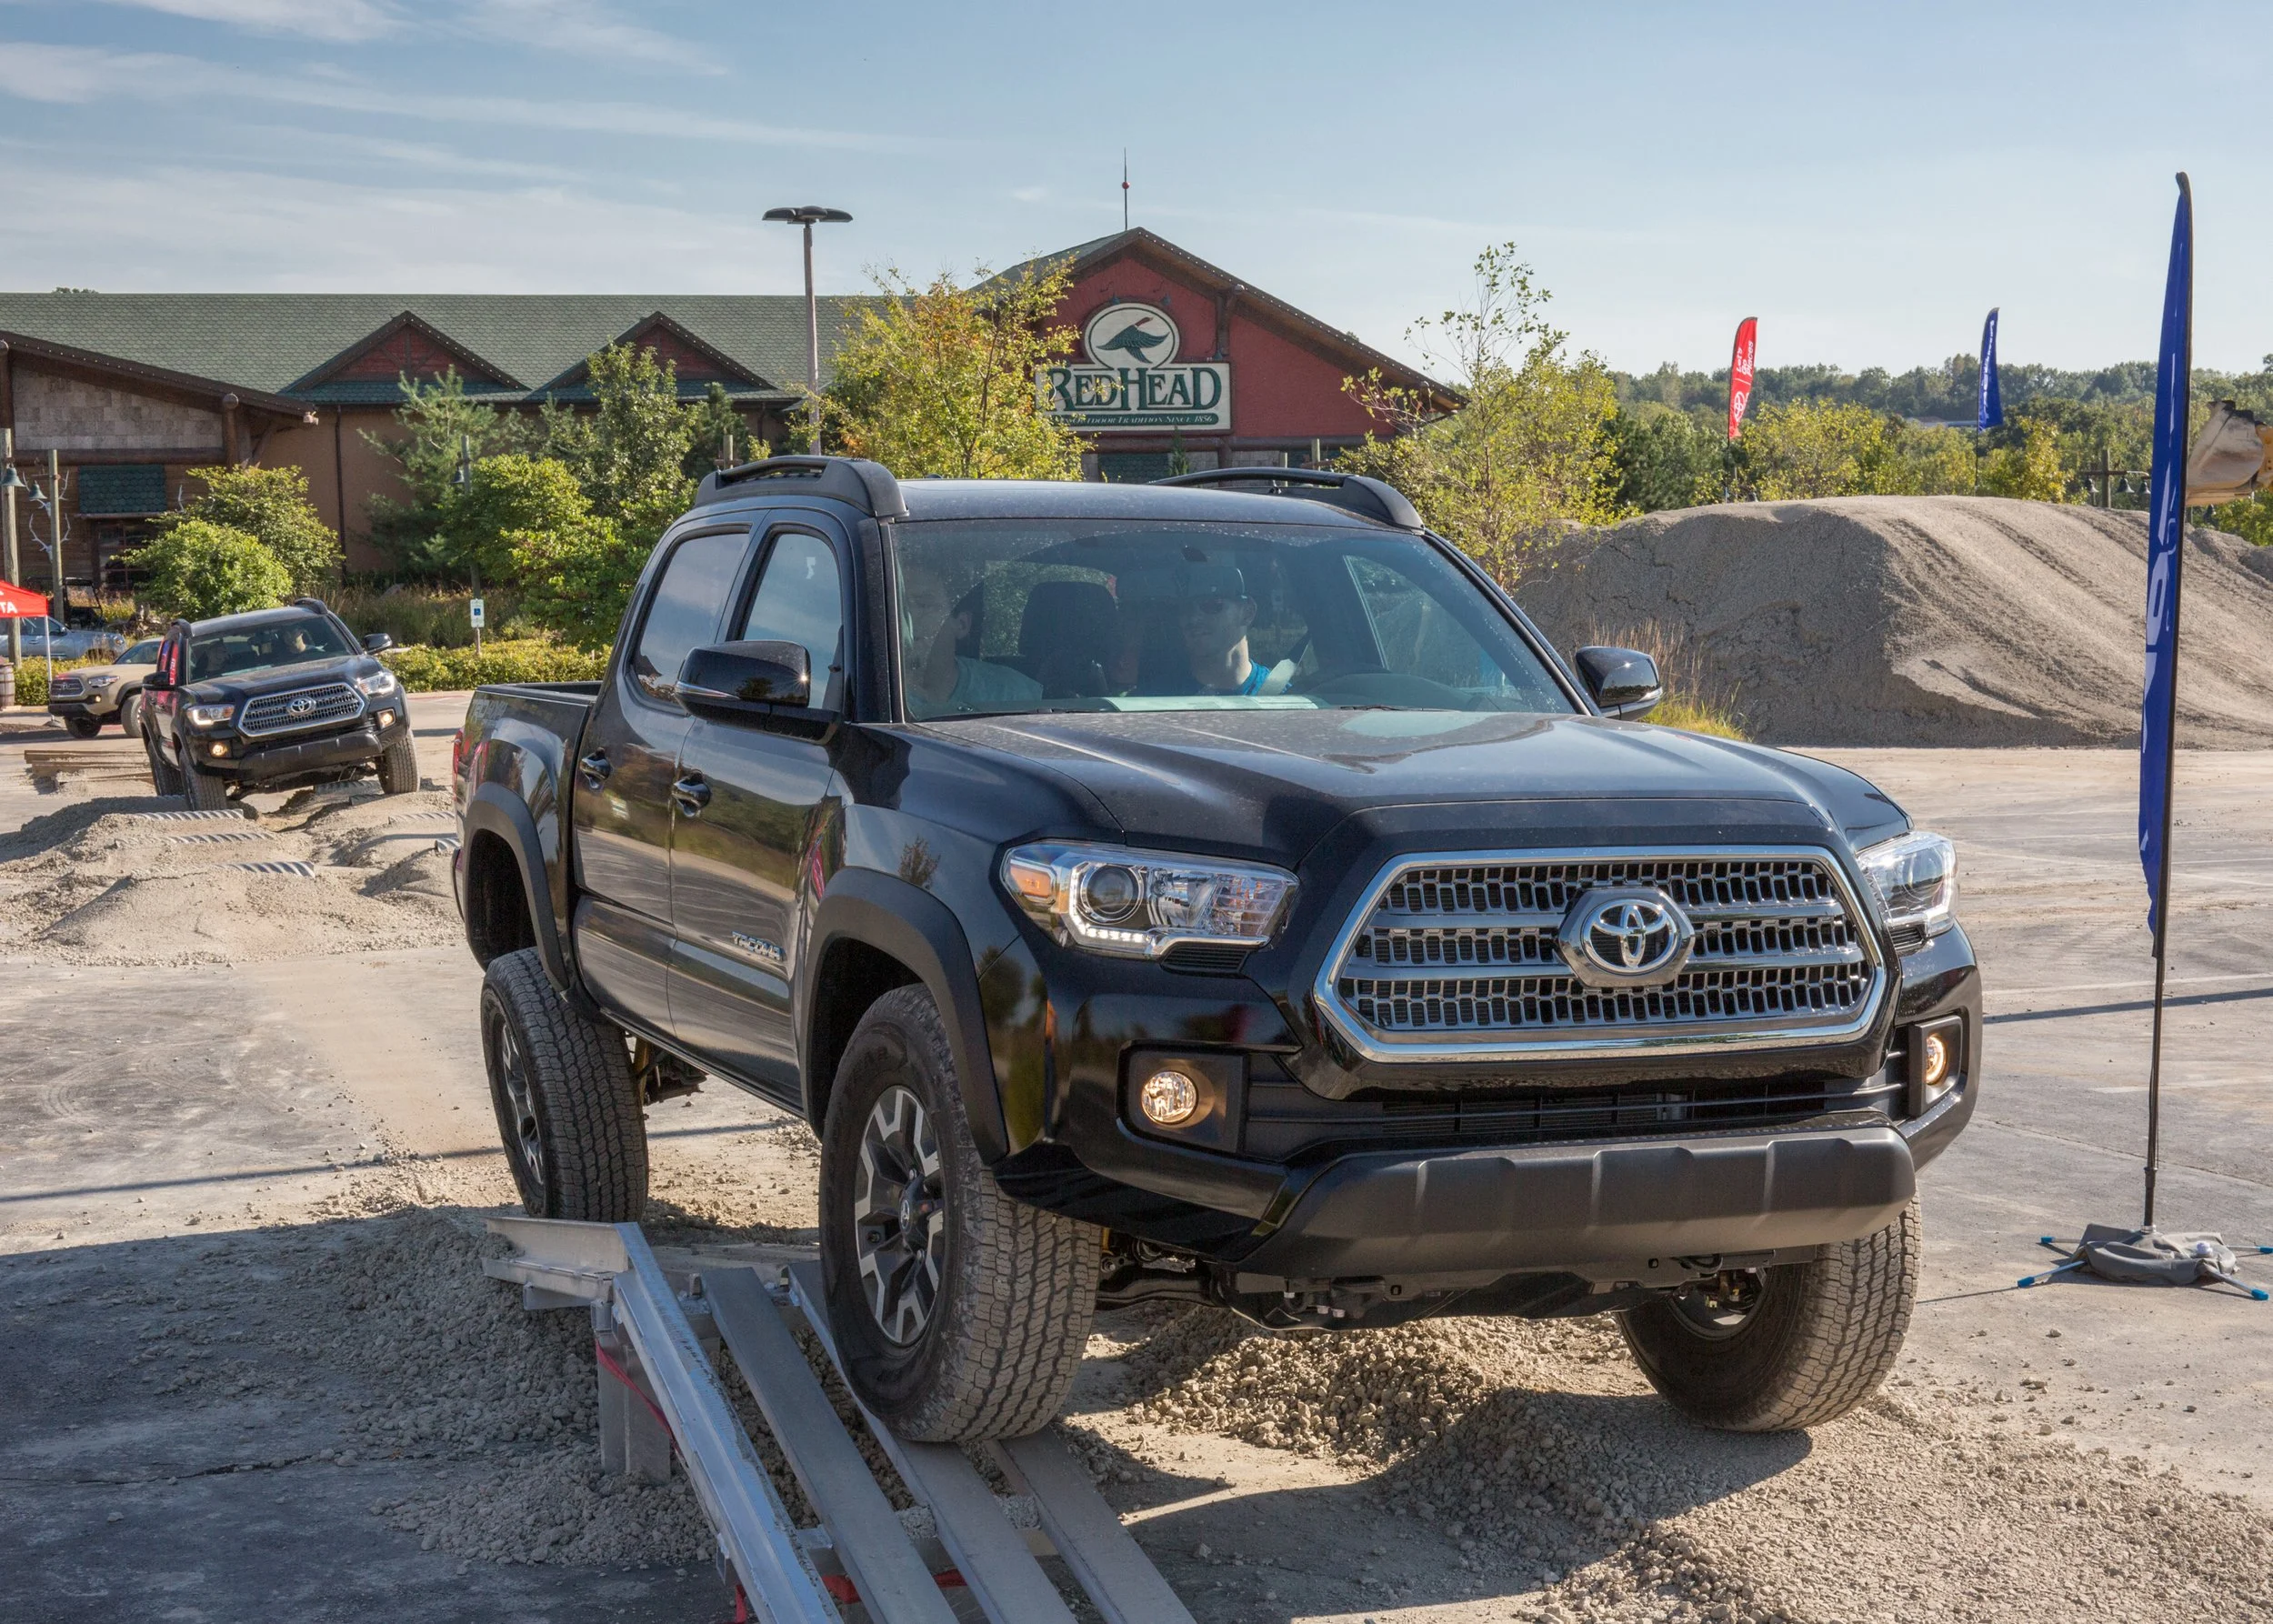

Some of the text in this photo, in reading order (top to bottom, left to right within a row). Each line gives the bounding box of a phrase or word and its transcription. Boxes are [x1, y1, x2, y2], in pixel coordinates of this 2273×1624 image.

[1117, 415, 1164, 425] TRADITION
[1166, 414, 1192, 424] SINCE
[1194, 415, 1214, 423] 1856
[731, 931, 781, 961] TACOMA
